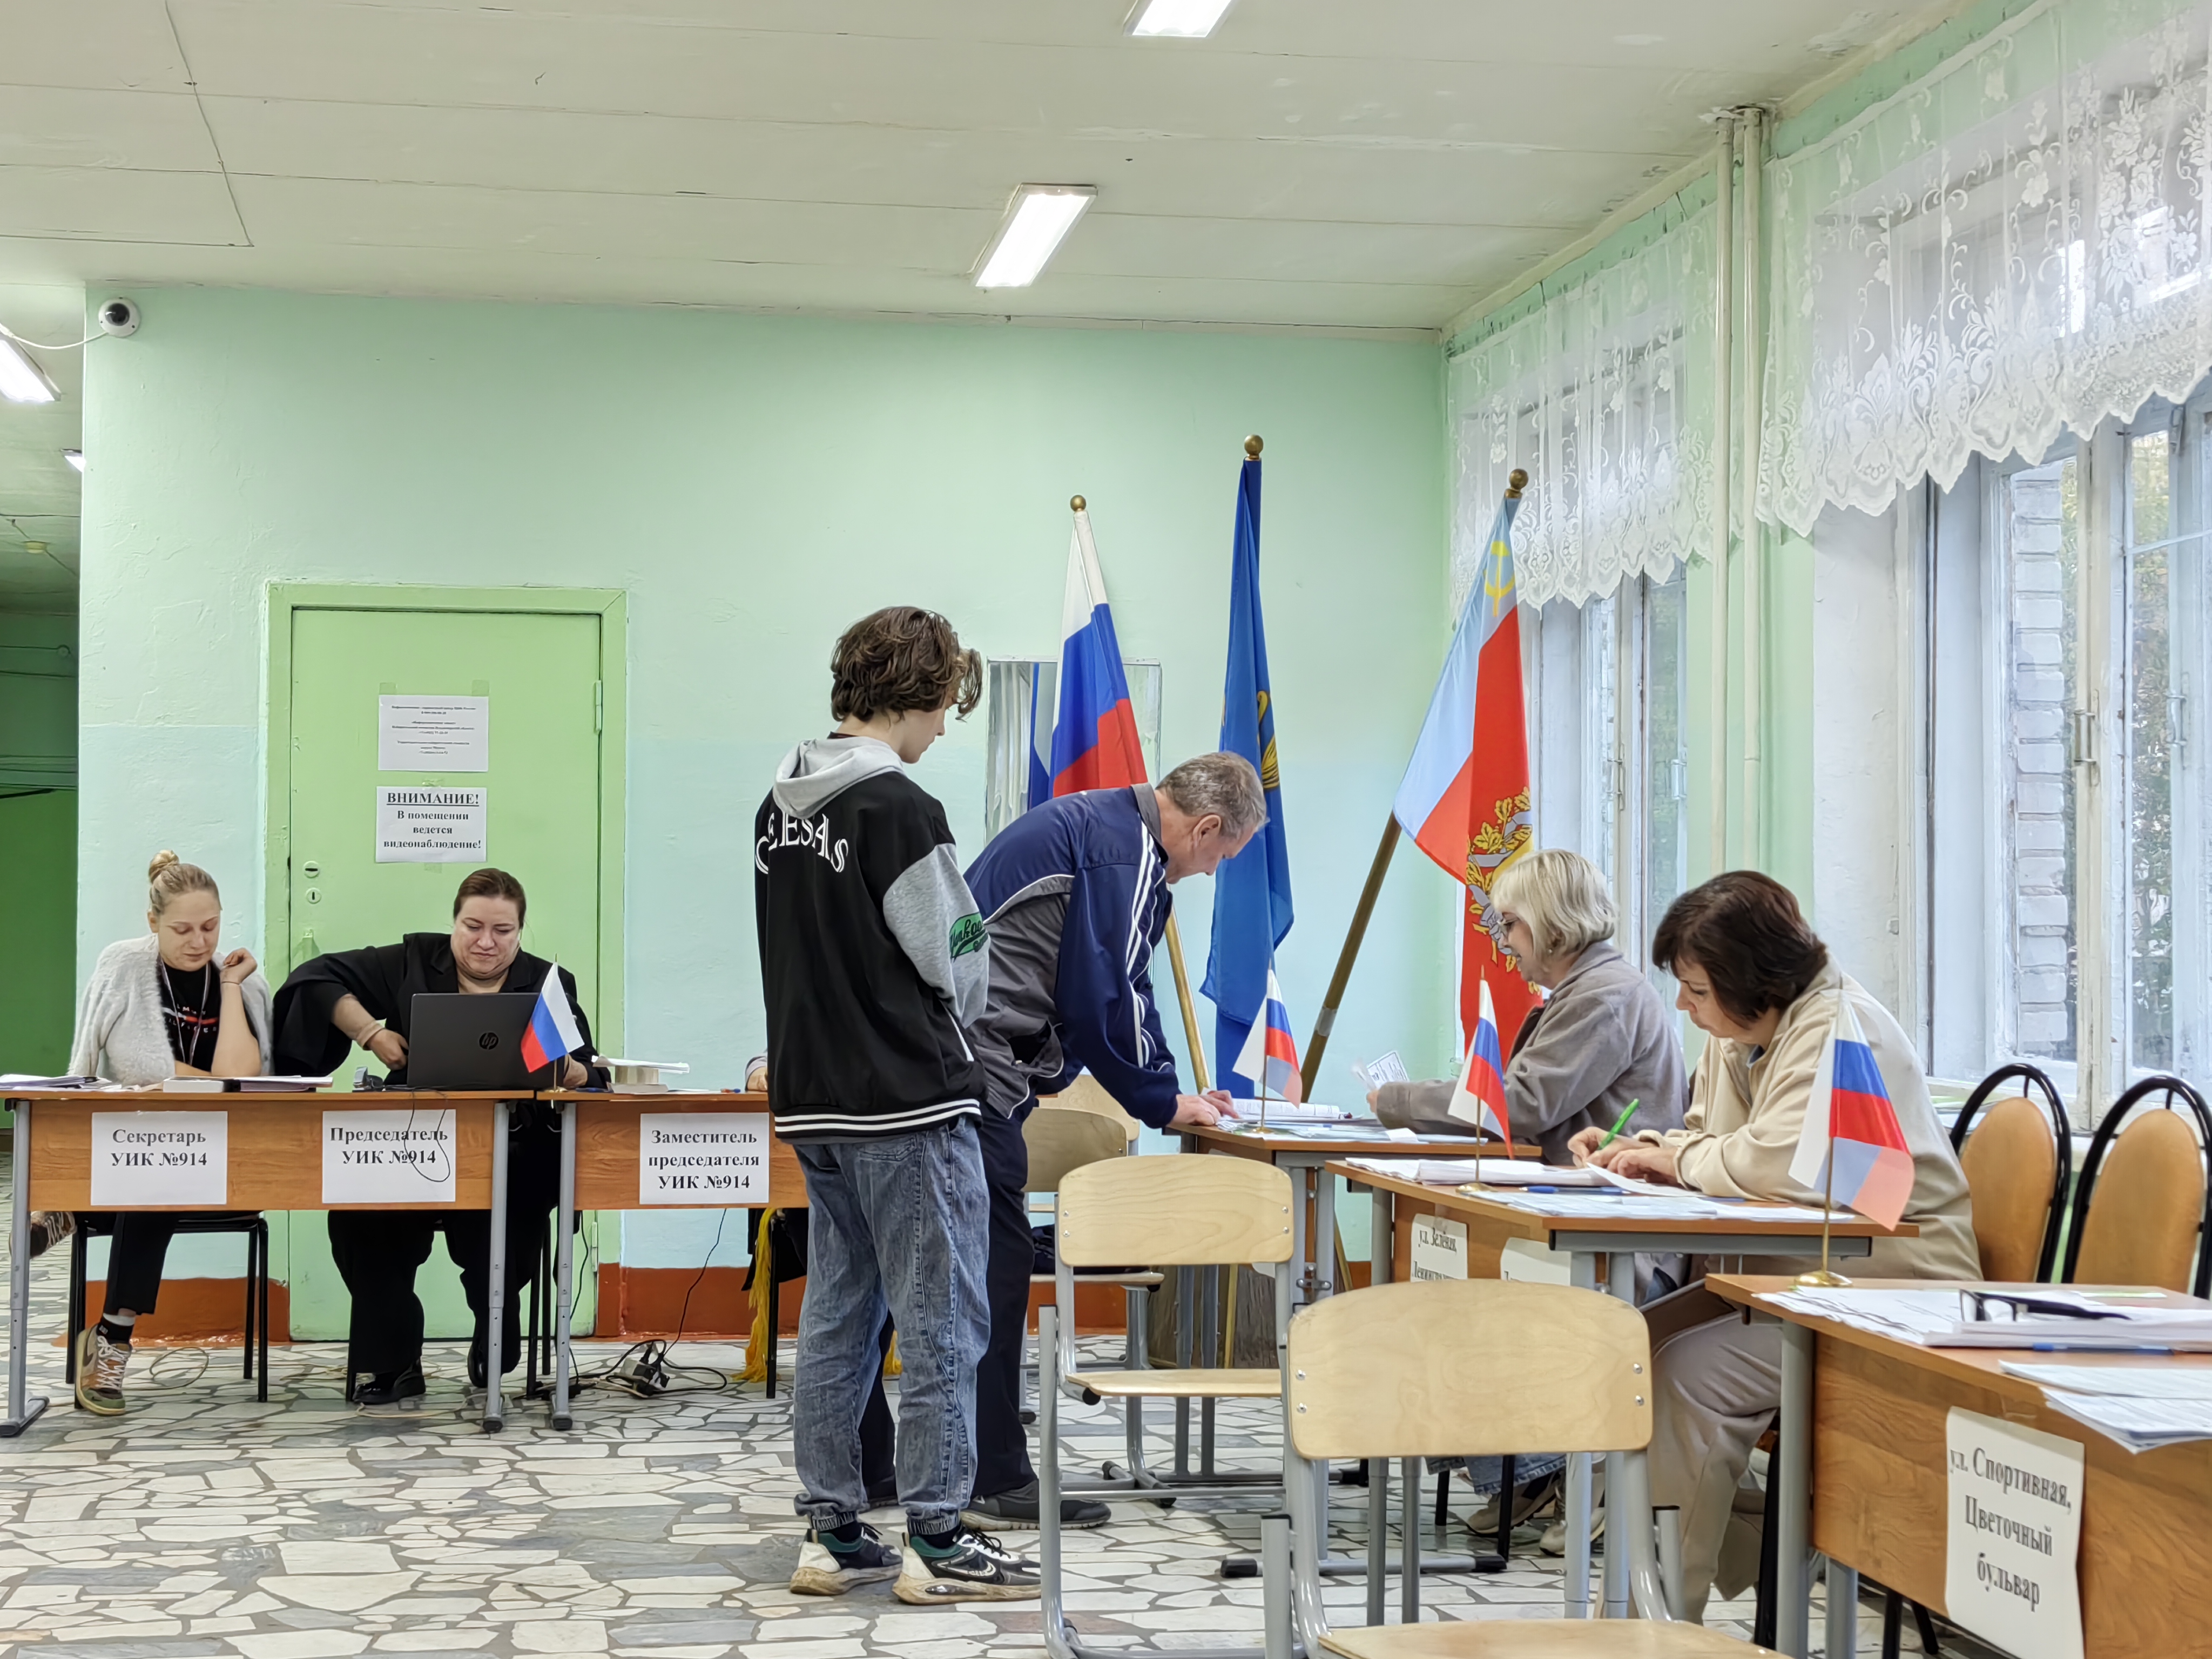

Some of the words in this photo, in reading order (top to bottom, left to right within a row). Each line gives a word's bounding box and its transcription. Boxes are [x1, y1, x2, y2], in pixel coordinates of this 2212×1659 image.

[388, 792, 479, 805] ВНИМАНИЕ!
[397, 811, 404, 819] В
[383, 839, 481, 849] видеонаблюдение!
[479, 1032, 499, 1050] hp
[112, 1129, 207, 1147] Секретарь
[330, 1127, 448, 1145] Председатель
[651, 1129, 758, 1144] Заместитель
[111, 1152, 154, 1166] УИК
[158, 1152, 207, 1166] №914
[342, 1150, 384, 1164] УИК
[388, 1150, 436, 1164] №914
[648, 1156, 759, 1170] председателя
[658, 1175, 700, 1189] УИК
[703, 1175, 750, 1189] №914
[1950, 1449, 1969, 1474] ул.
[1973, 1447, 2072, 1515] Спортивная,
[1965, 1495, 2053, 1557] Цветочный
[1977, 1552, 2040, 1613] бульвар
